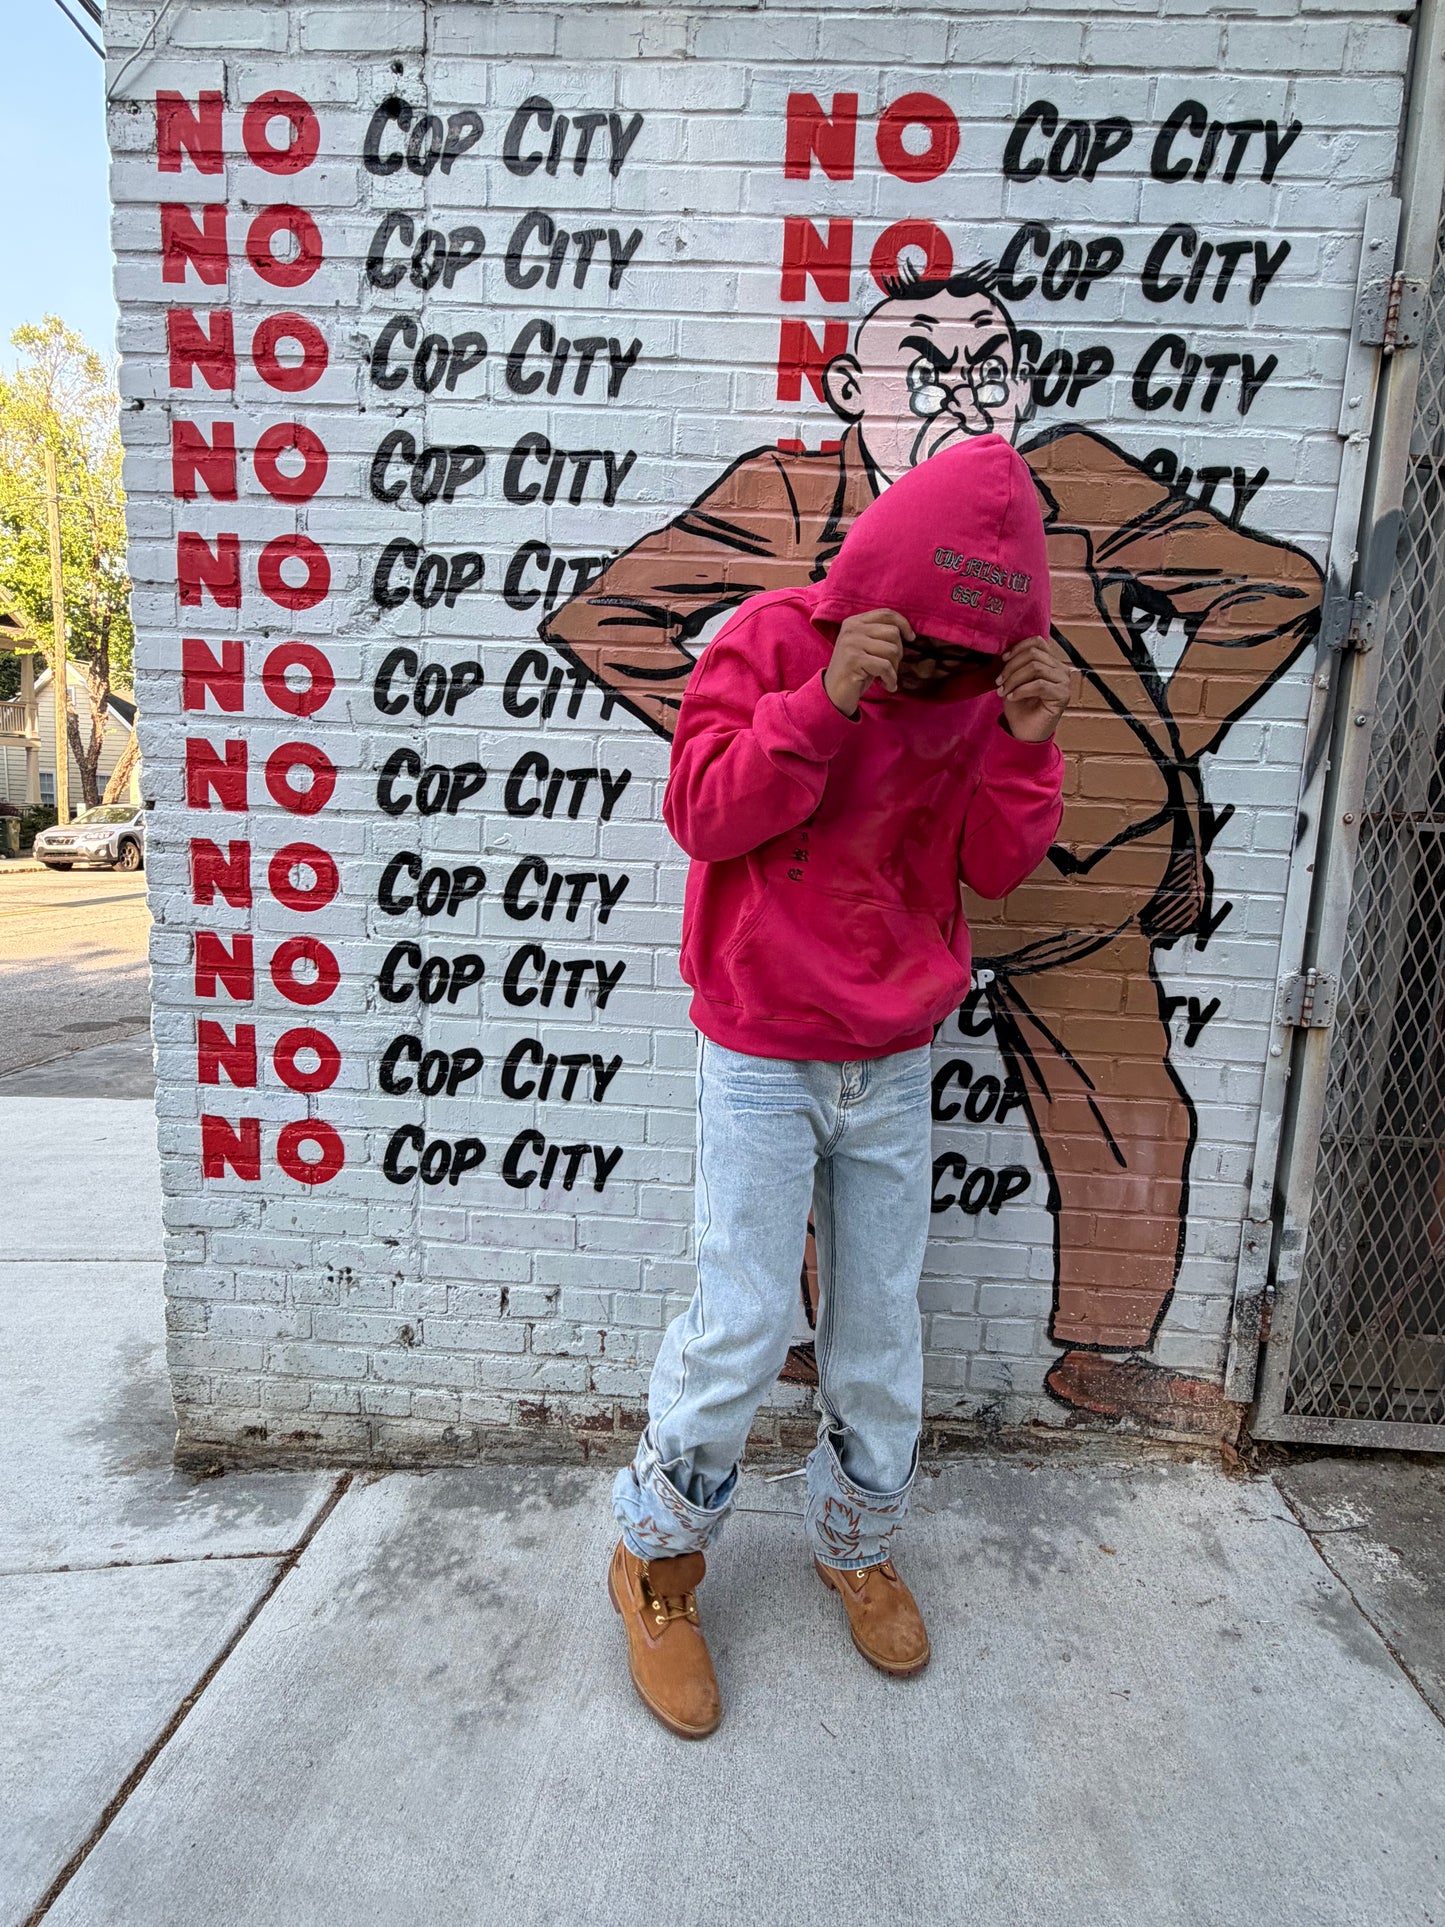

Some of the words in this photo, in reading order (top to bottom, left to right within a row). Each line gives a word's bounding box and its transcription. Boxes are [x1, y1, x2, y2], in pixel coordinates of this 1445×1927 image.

[156, 90, 320, 175] NO
[363, 99, 484, 176] COP
[503, 96, 644, 177] CITY
[783, 92, 960, 183] NO
[1003, 100, 1132, 183] COP
[1150, 100, 1303, 185] CITY
[160, 202, 323, 287] NO
[366, 213, 486, 290] COP
[504, 212, 643, 290] CITY
[780, 217, 954, 303] NO
[997, 221, 1124, 302] COP
[1141, 222, 1291, 305] CITY
[167, 309, 329, 392] NO
[370, 315, 488, 394] COP
[505, 319, 643, 398] CITY
[776, 320, 849, 403] N
[1132, 333, 1278, 415] CITY
[172, 421, 328, 504] NO
[370, 430, 487, 505] COP
[503, 432, 638, 507] CITY
[177, 531, 331, 611] NO
[373, 537, 485, 610] COP
[504, 540, 612, 611] CIT
[182, 639, 335, 717] NO
[373, 648, 484, 717] COP
[186, 738, 337, 816] NO
[376, 747, 488, 818] COP
[503, 751, 632, 822] CITY
[190, 838, 340, 912] NO
[377, 851, 486, 917] COP
[502, 855, 629, 924] CITY
[195, 932, 341, 1006] NO
[378, 940, 485, 1004] COP
[502, 944, 627, 1009] CITY
[197, 1020, 341, 1093] NO
[378, 1034, 483, 1097] COP
[500, 1038, 623, 1103] CITY
[931, 1059, 1027, 1123] COP
[200, 1115, 345, 1184] NO
[383, 1123, 487, 1186] COP
[502, 1128, 624, 1193] CITY
[930, 1152, 1031, 1215] COP
